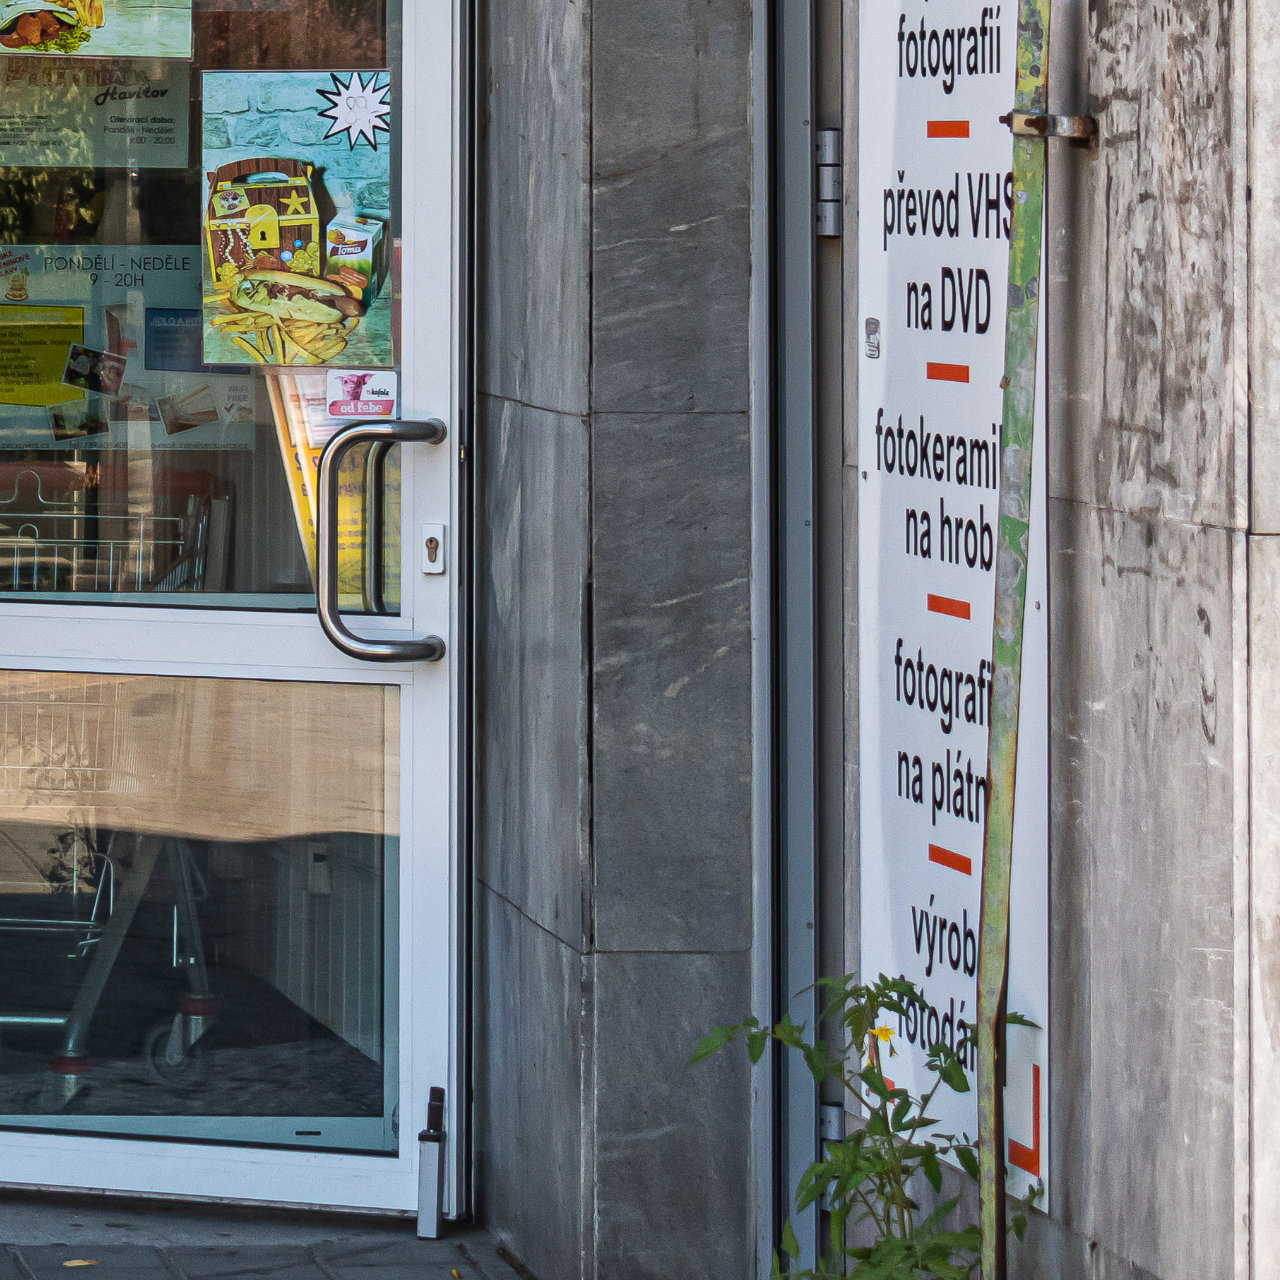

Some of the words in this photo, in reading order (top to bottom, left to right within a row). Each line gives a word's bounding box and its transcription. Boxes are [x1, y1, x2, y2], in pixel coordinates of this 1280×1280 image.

[897, 5, 1001, 95] fotografií
[883, 170, 959, 251] převod
[43, 254, 116, 271] PONDĚLÍ
[130, 254, 191, 271] NEDĚLE
[89, 274, 99, 287] 9
[114, 274, 144, 287] 20H
[906, 281, 933, 331] na
[941, 266, 991, 335] DVD
[875, 407, 1003, 490] fotokerami
[905, 508, 932, 559] na
[940, 497, 994, 572] hrob
[895, 637, 992, 735] fotografi
[897, 750, 924, 805] na
[931, 748, 988, 827] plátn
[911, 894, 977, 978] výrob
